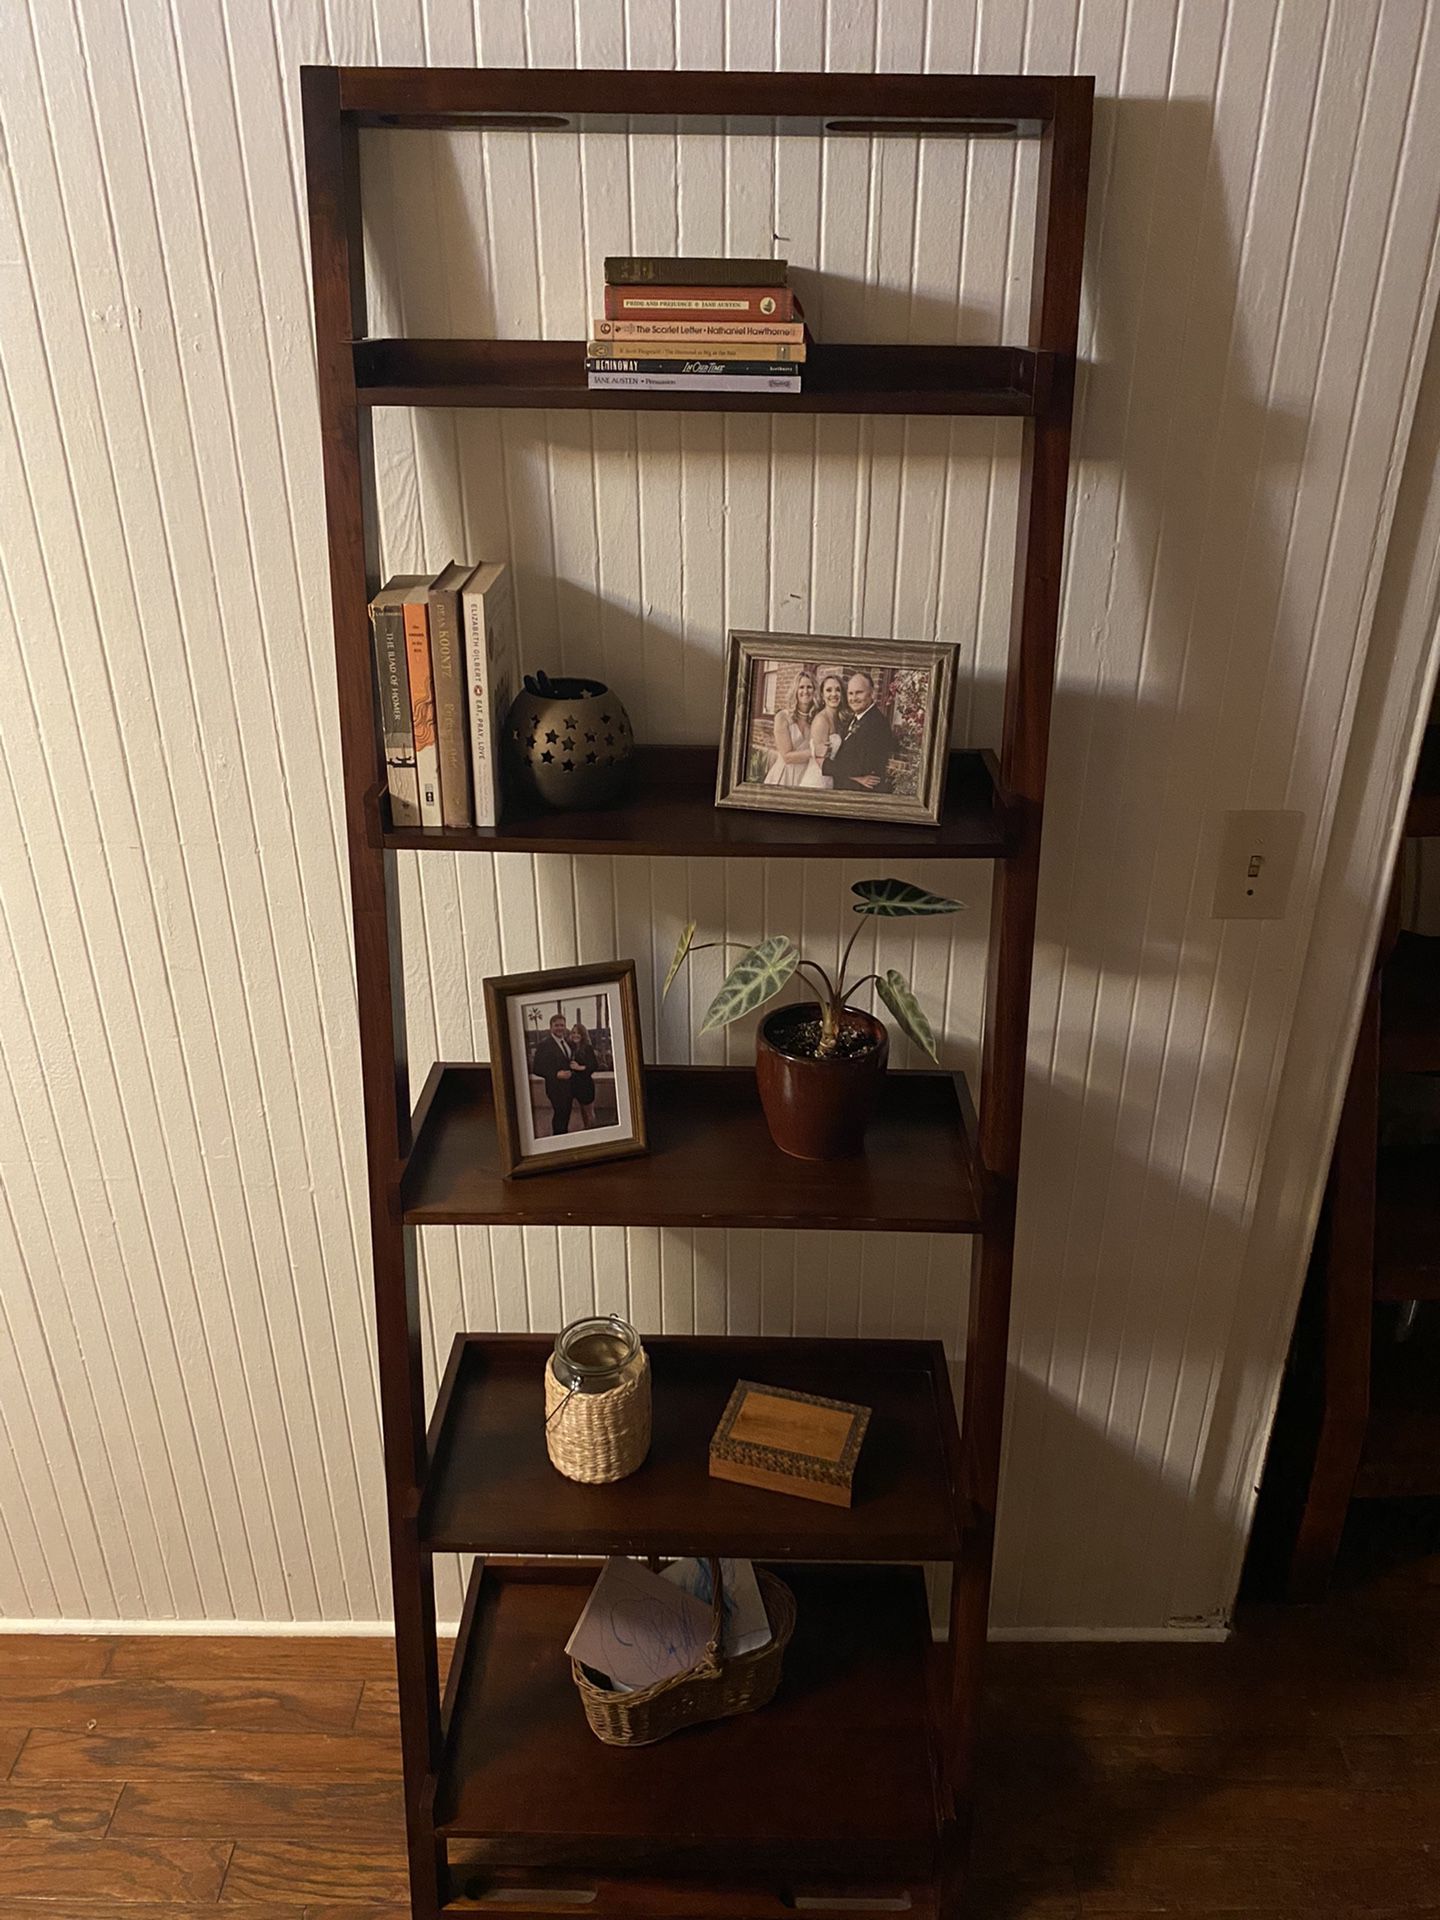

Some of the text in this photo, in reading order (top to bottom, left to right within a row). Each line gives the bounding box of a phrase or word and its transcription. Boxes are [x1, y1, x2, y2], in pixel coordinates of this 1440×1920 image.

[636, 325, 791, 336] The Scarlet Letter Nathaniel Hawthorne
[595, 359, 639, 371] HEMINGWAY
[593, 376, 639, 385] JANE AUSTEN
[438, 630, 453, 677] KOONTZ
[470, 603, 482, 682] ELIZABETH GILBERT
[386, 633, 401, 721] THE ILIAD OF HOMER
[477, 738, 486, 760] LOVE
